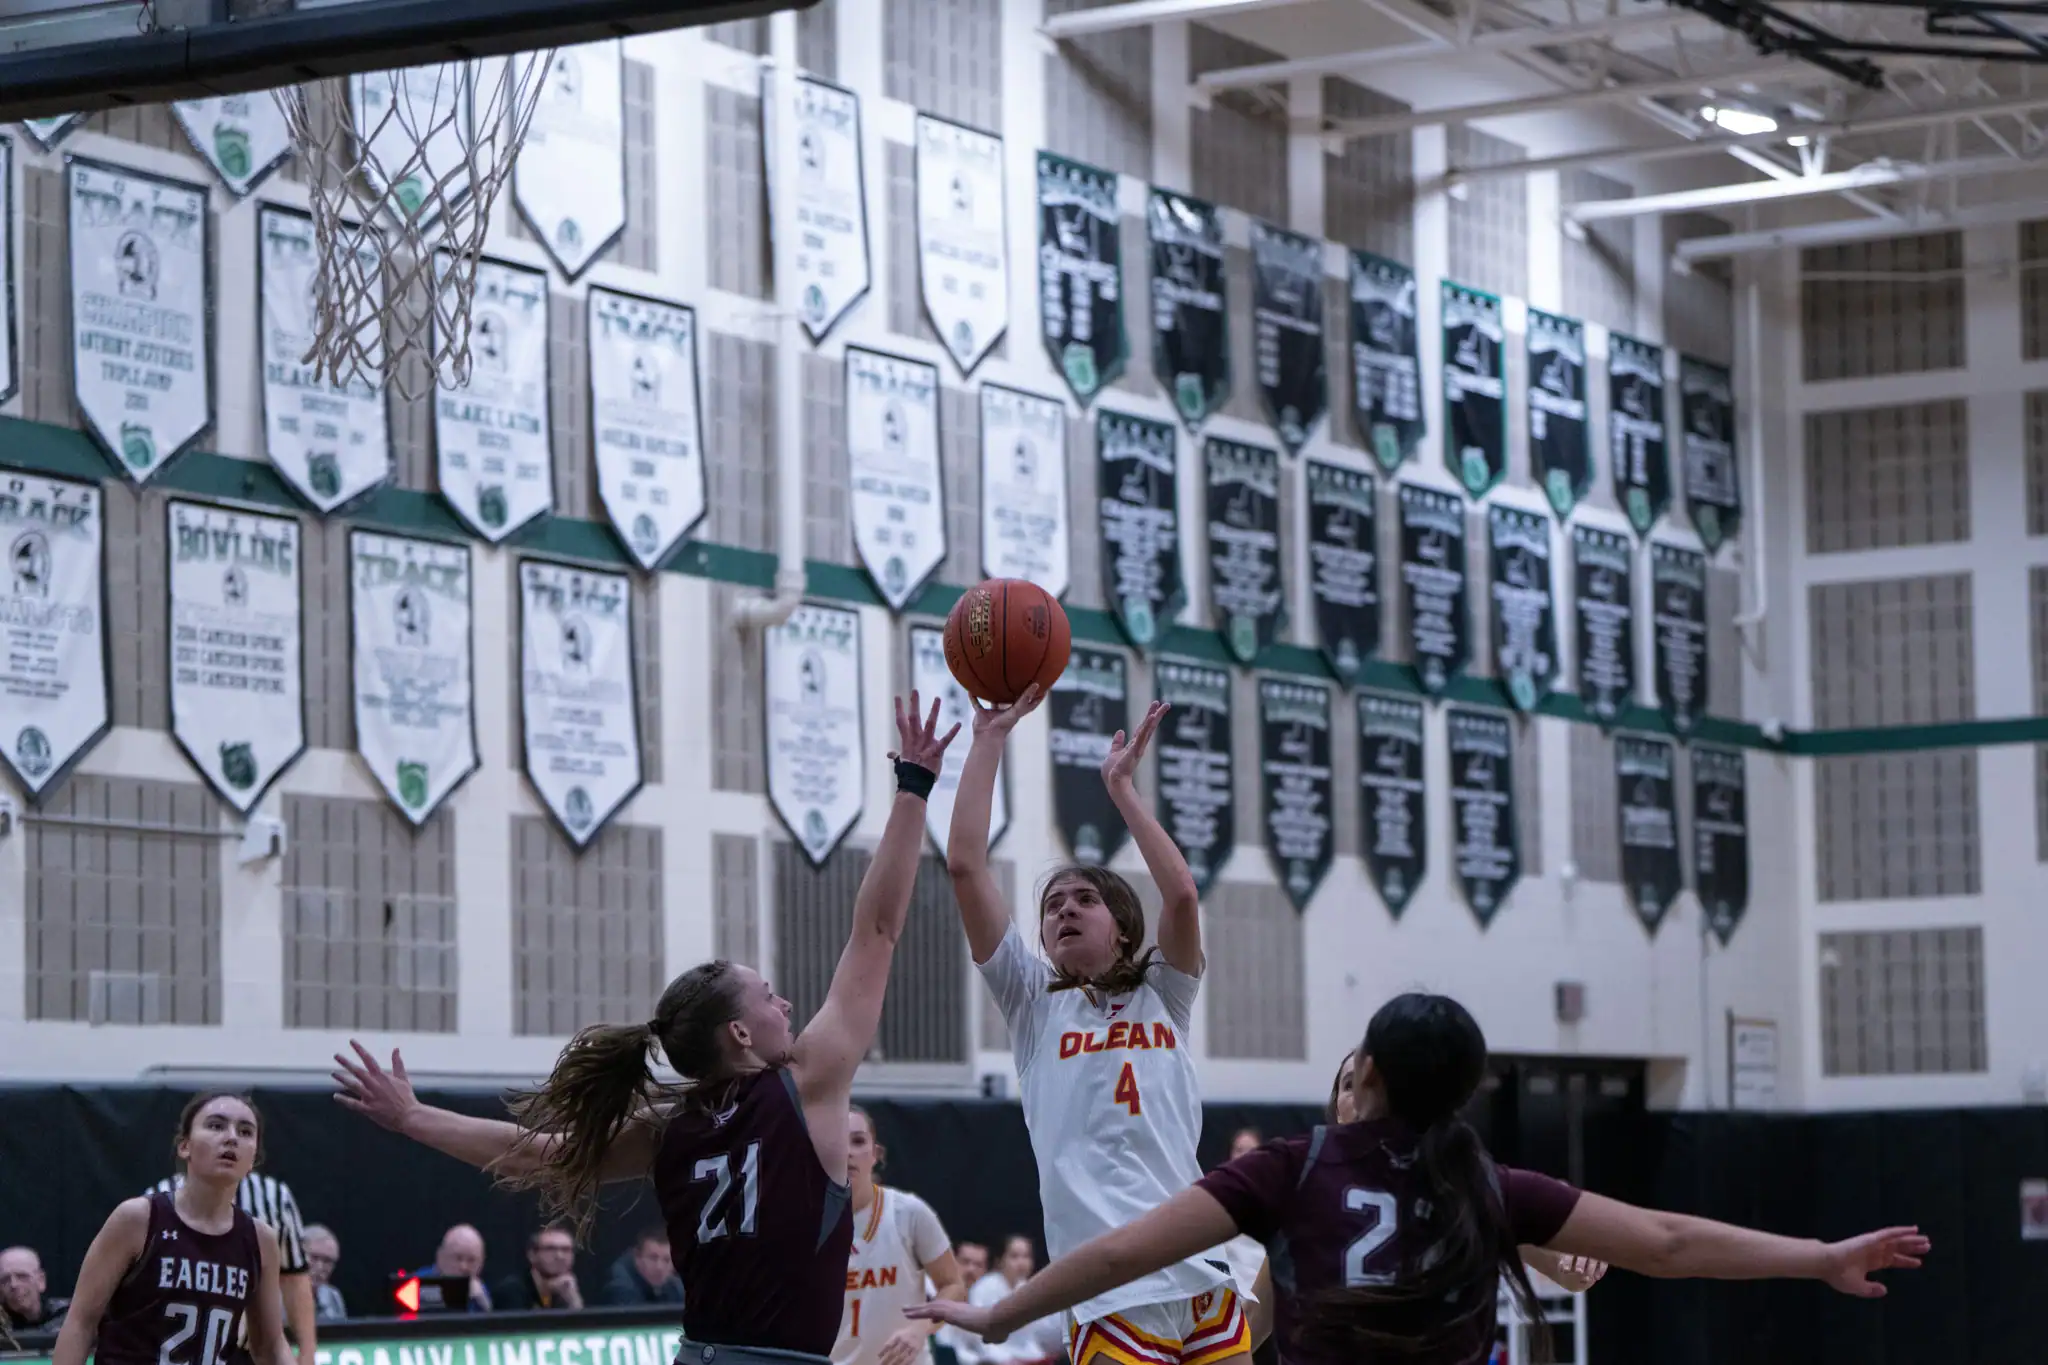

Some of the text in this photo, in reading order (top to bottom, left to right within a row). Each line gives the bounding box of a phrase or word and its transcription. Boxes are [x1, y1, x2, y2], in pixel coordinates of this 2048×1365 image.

[177, 525, 292, 578] BOWLING
[1059, 1020, 1177, 1060] OLEAN
[1113, 1061, 1142, 1117] 4
[691, 1138, 761, 1245] 21
[158, 1255, 250, 1300] EAGLES
[157, 1301, 234, 1365] 20
[850, 1298, 861, 1337] 1
